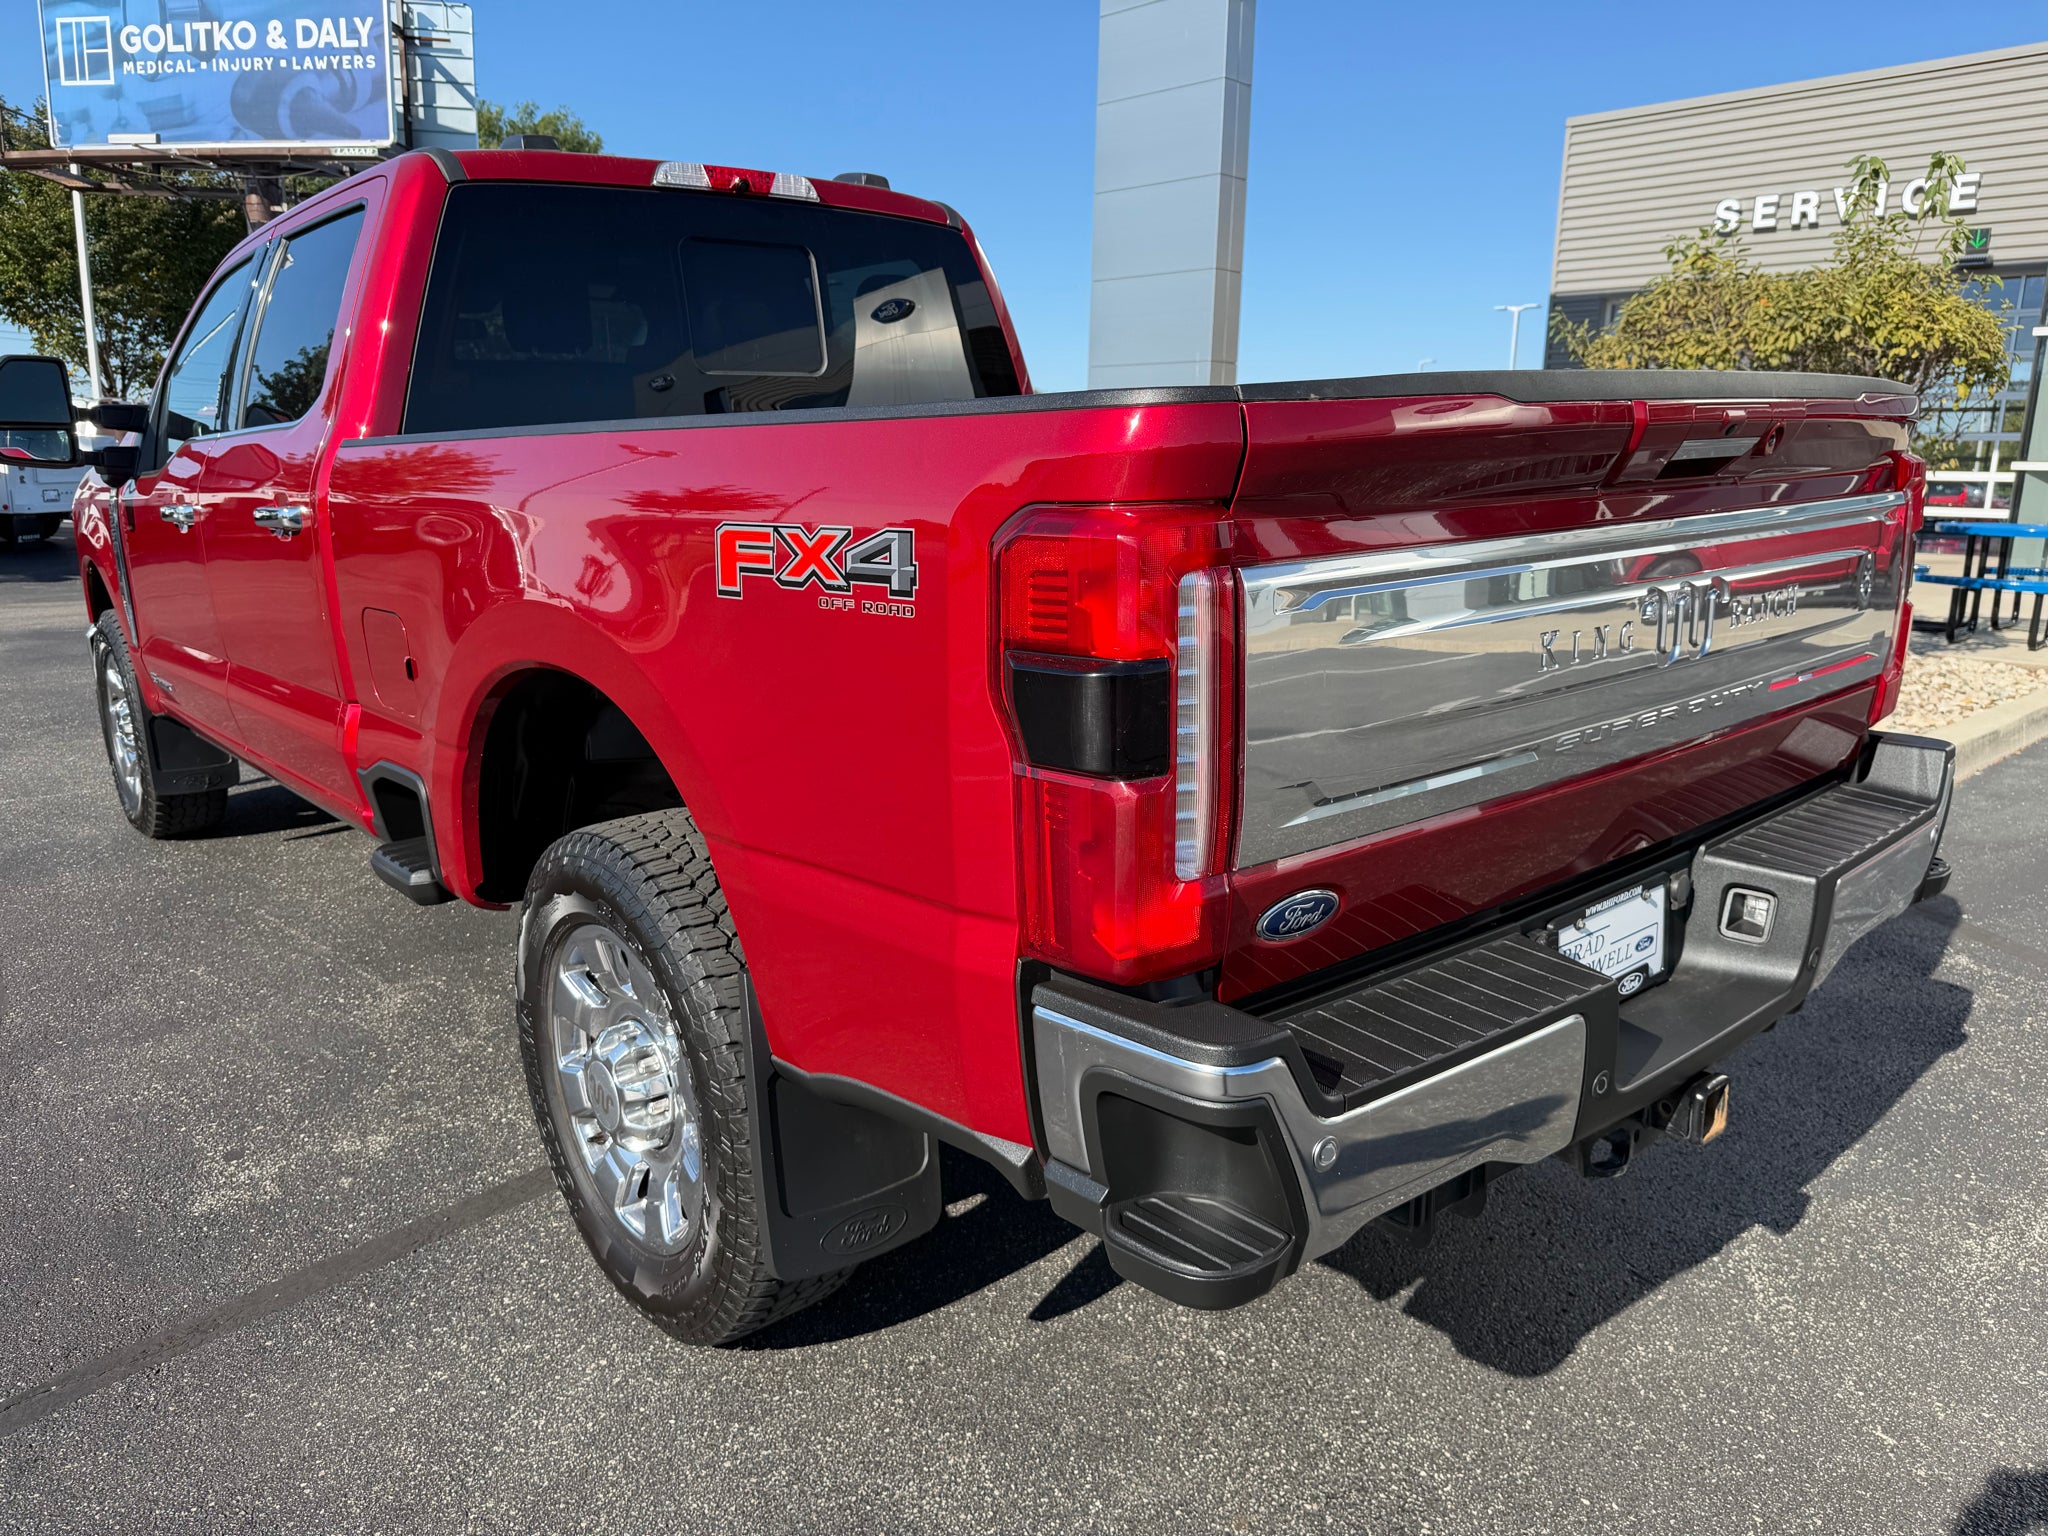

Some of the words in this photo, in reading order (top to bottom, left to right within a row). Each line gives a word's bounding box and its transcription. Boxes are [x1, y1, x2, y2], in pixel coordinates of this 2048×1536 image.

[120, 21, 257, 54] GOLITKO
[266, 19, 288, 50] &
[295, 16, 374, 49] DALY
[123, 60, 196, 75] MEDICAL
[213, 57, 274, 72] INJURY
[292, 55, 376, 71] LAWYERS
[1714, 172, 1982, 235] SERVICE
[715, 521, 919, 600] FX4
[818, 596, 855, 612] OFF
[861, 601, 916, 619] ROAD
[1538, 620, 1634, 673] KING
[1729, 583, 1799, 630] RANCH
[1555, 704, 1680, 752] SUPER
[1687, 681, 1764, 714] DUTY
